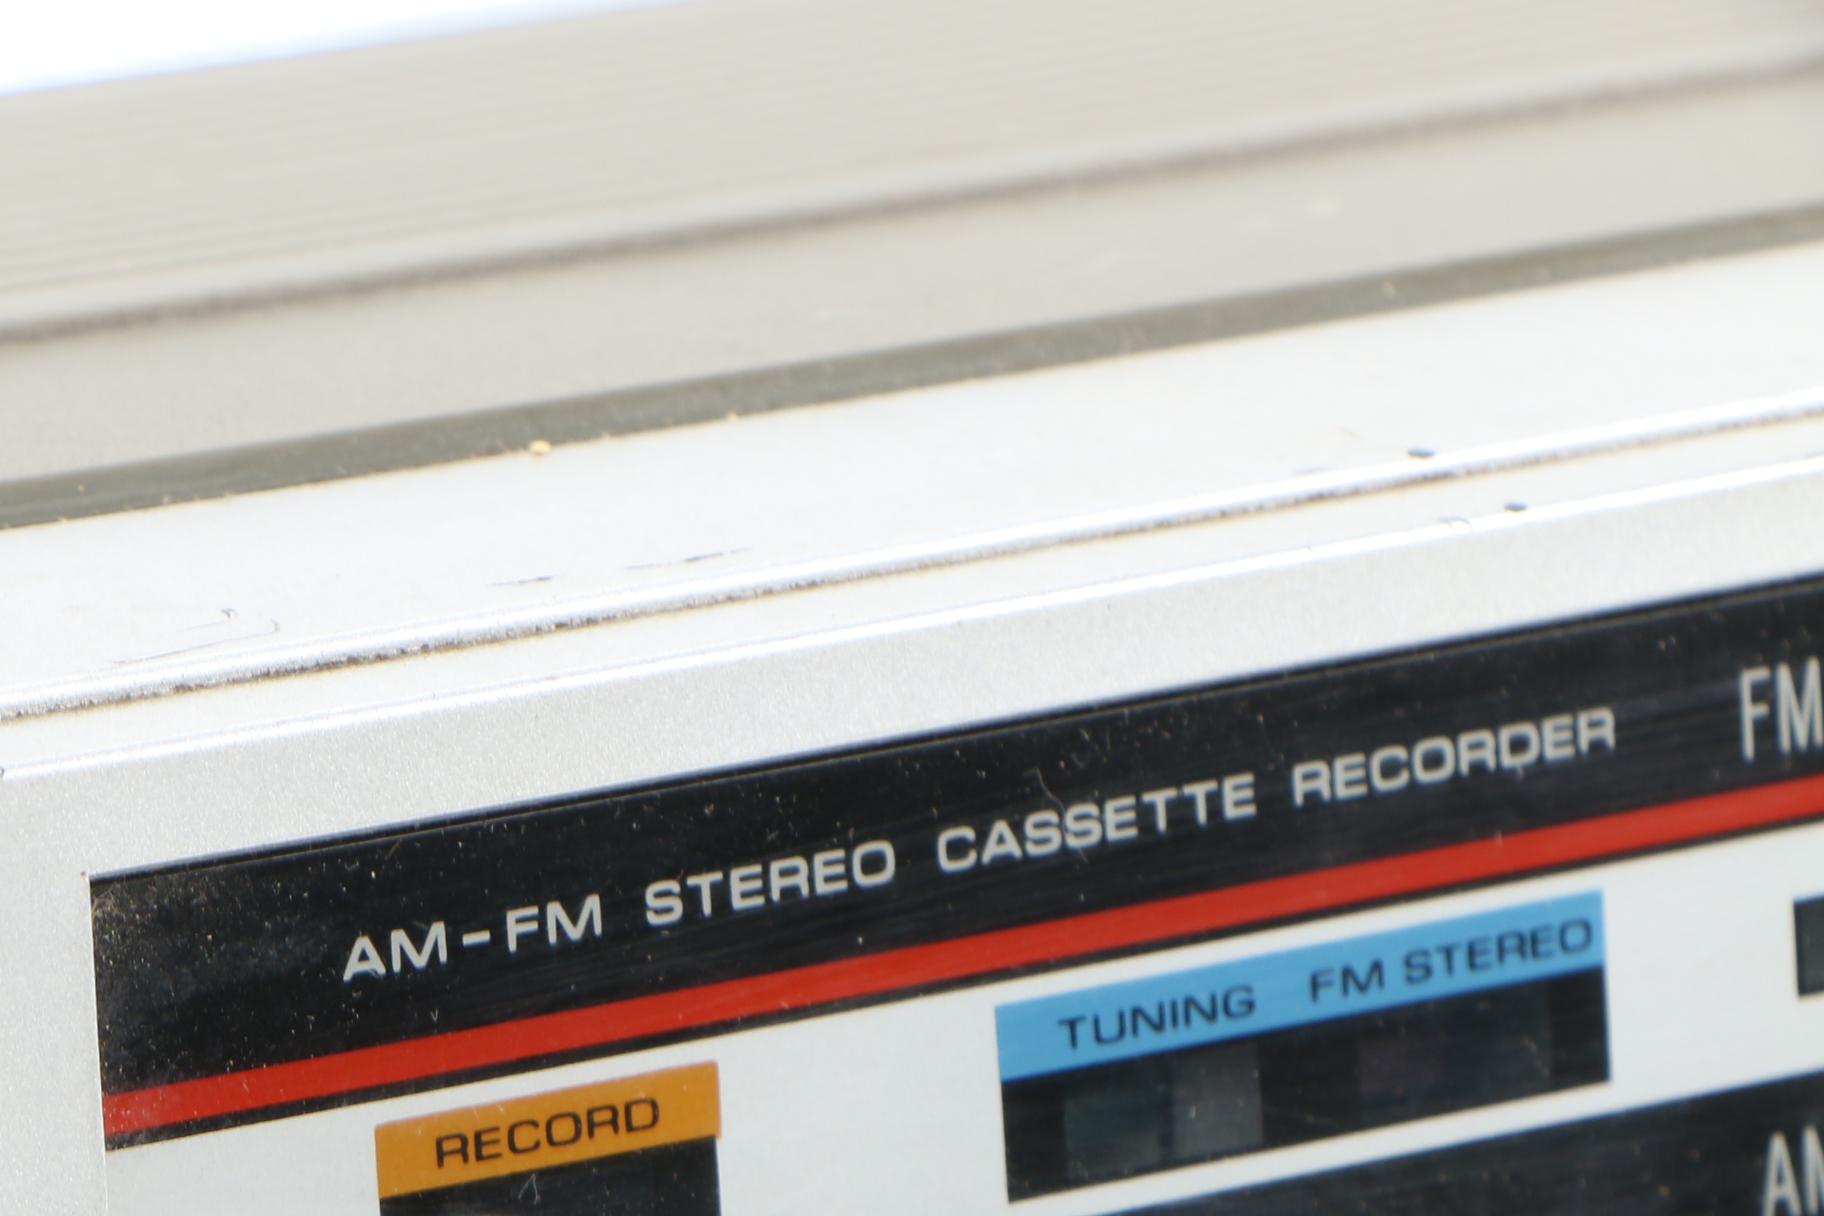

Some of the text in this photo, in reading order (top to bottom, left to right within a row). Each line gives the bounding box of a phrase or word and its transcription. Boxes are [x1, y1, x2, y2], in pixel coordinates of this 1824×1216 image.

[1739, 655, 1824, 762] FM
[643, 838, 898, 927] STEREO
[936, 773, 1257, 875] CASSETTE
[1292, 706, 1618, 808] RECORDER
[1058, 917, 1593, 1051] TUNING FM STEREO
[434, 1096, 661, 1169] RECORD
